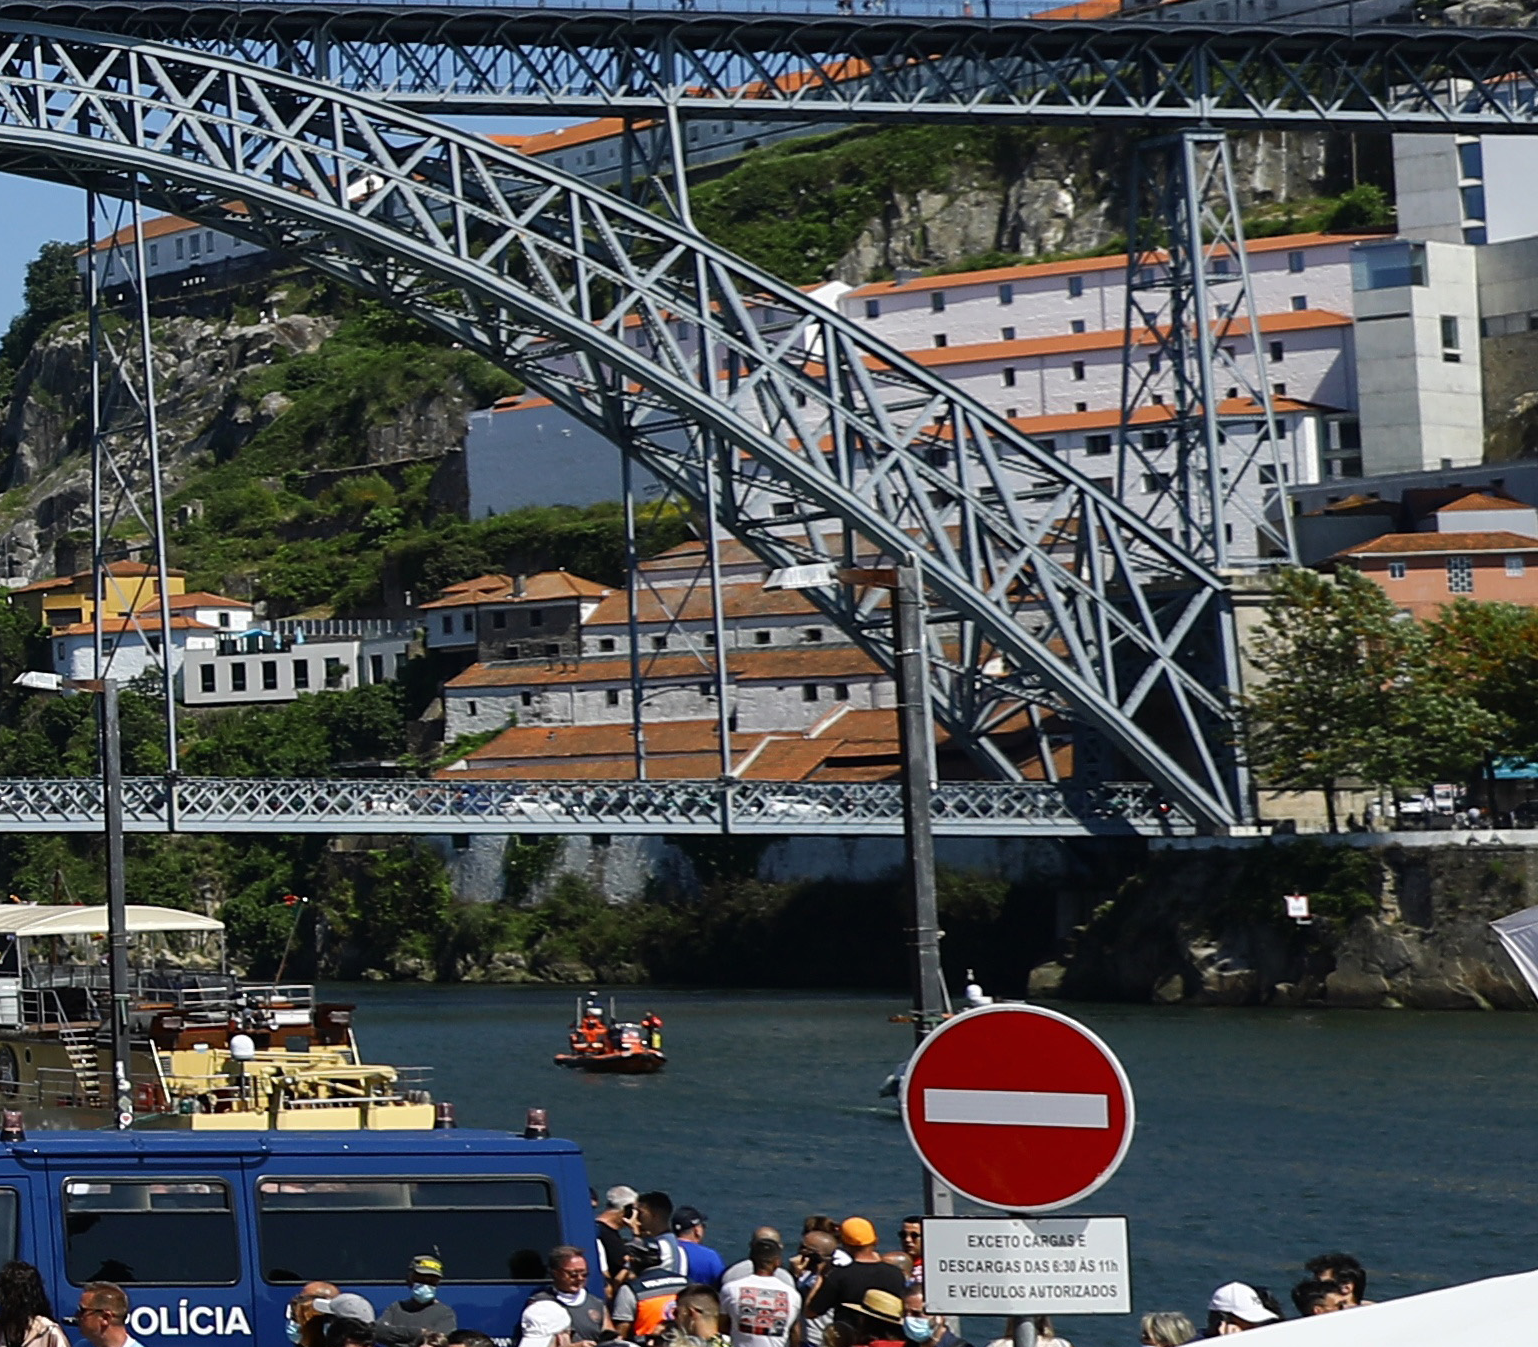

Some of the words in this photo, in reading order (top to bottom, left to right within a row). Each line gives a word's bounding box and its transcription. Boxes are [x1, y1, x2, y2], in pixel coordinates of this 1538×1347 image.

[968, 1234, 1020, 1248] EXCETO
[1022, 1234, 1075, 1248] CARGAS
[1077, 1234, 1087, 1247] E
[939, 1259, 1021, 1273] DESCARGAS
[1024, 1259, 1050, 1272] DAS
[1052, 1260, 1076, 1273] 6:30
[948, 1284, 957, 1298] E
[959, 1281, 1026, 1298] VEÍCULOS
[1028, 1284, 1118, 1298] AUTORIZADOS
[124, 1299, 252, 1336] OLÍCIA
